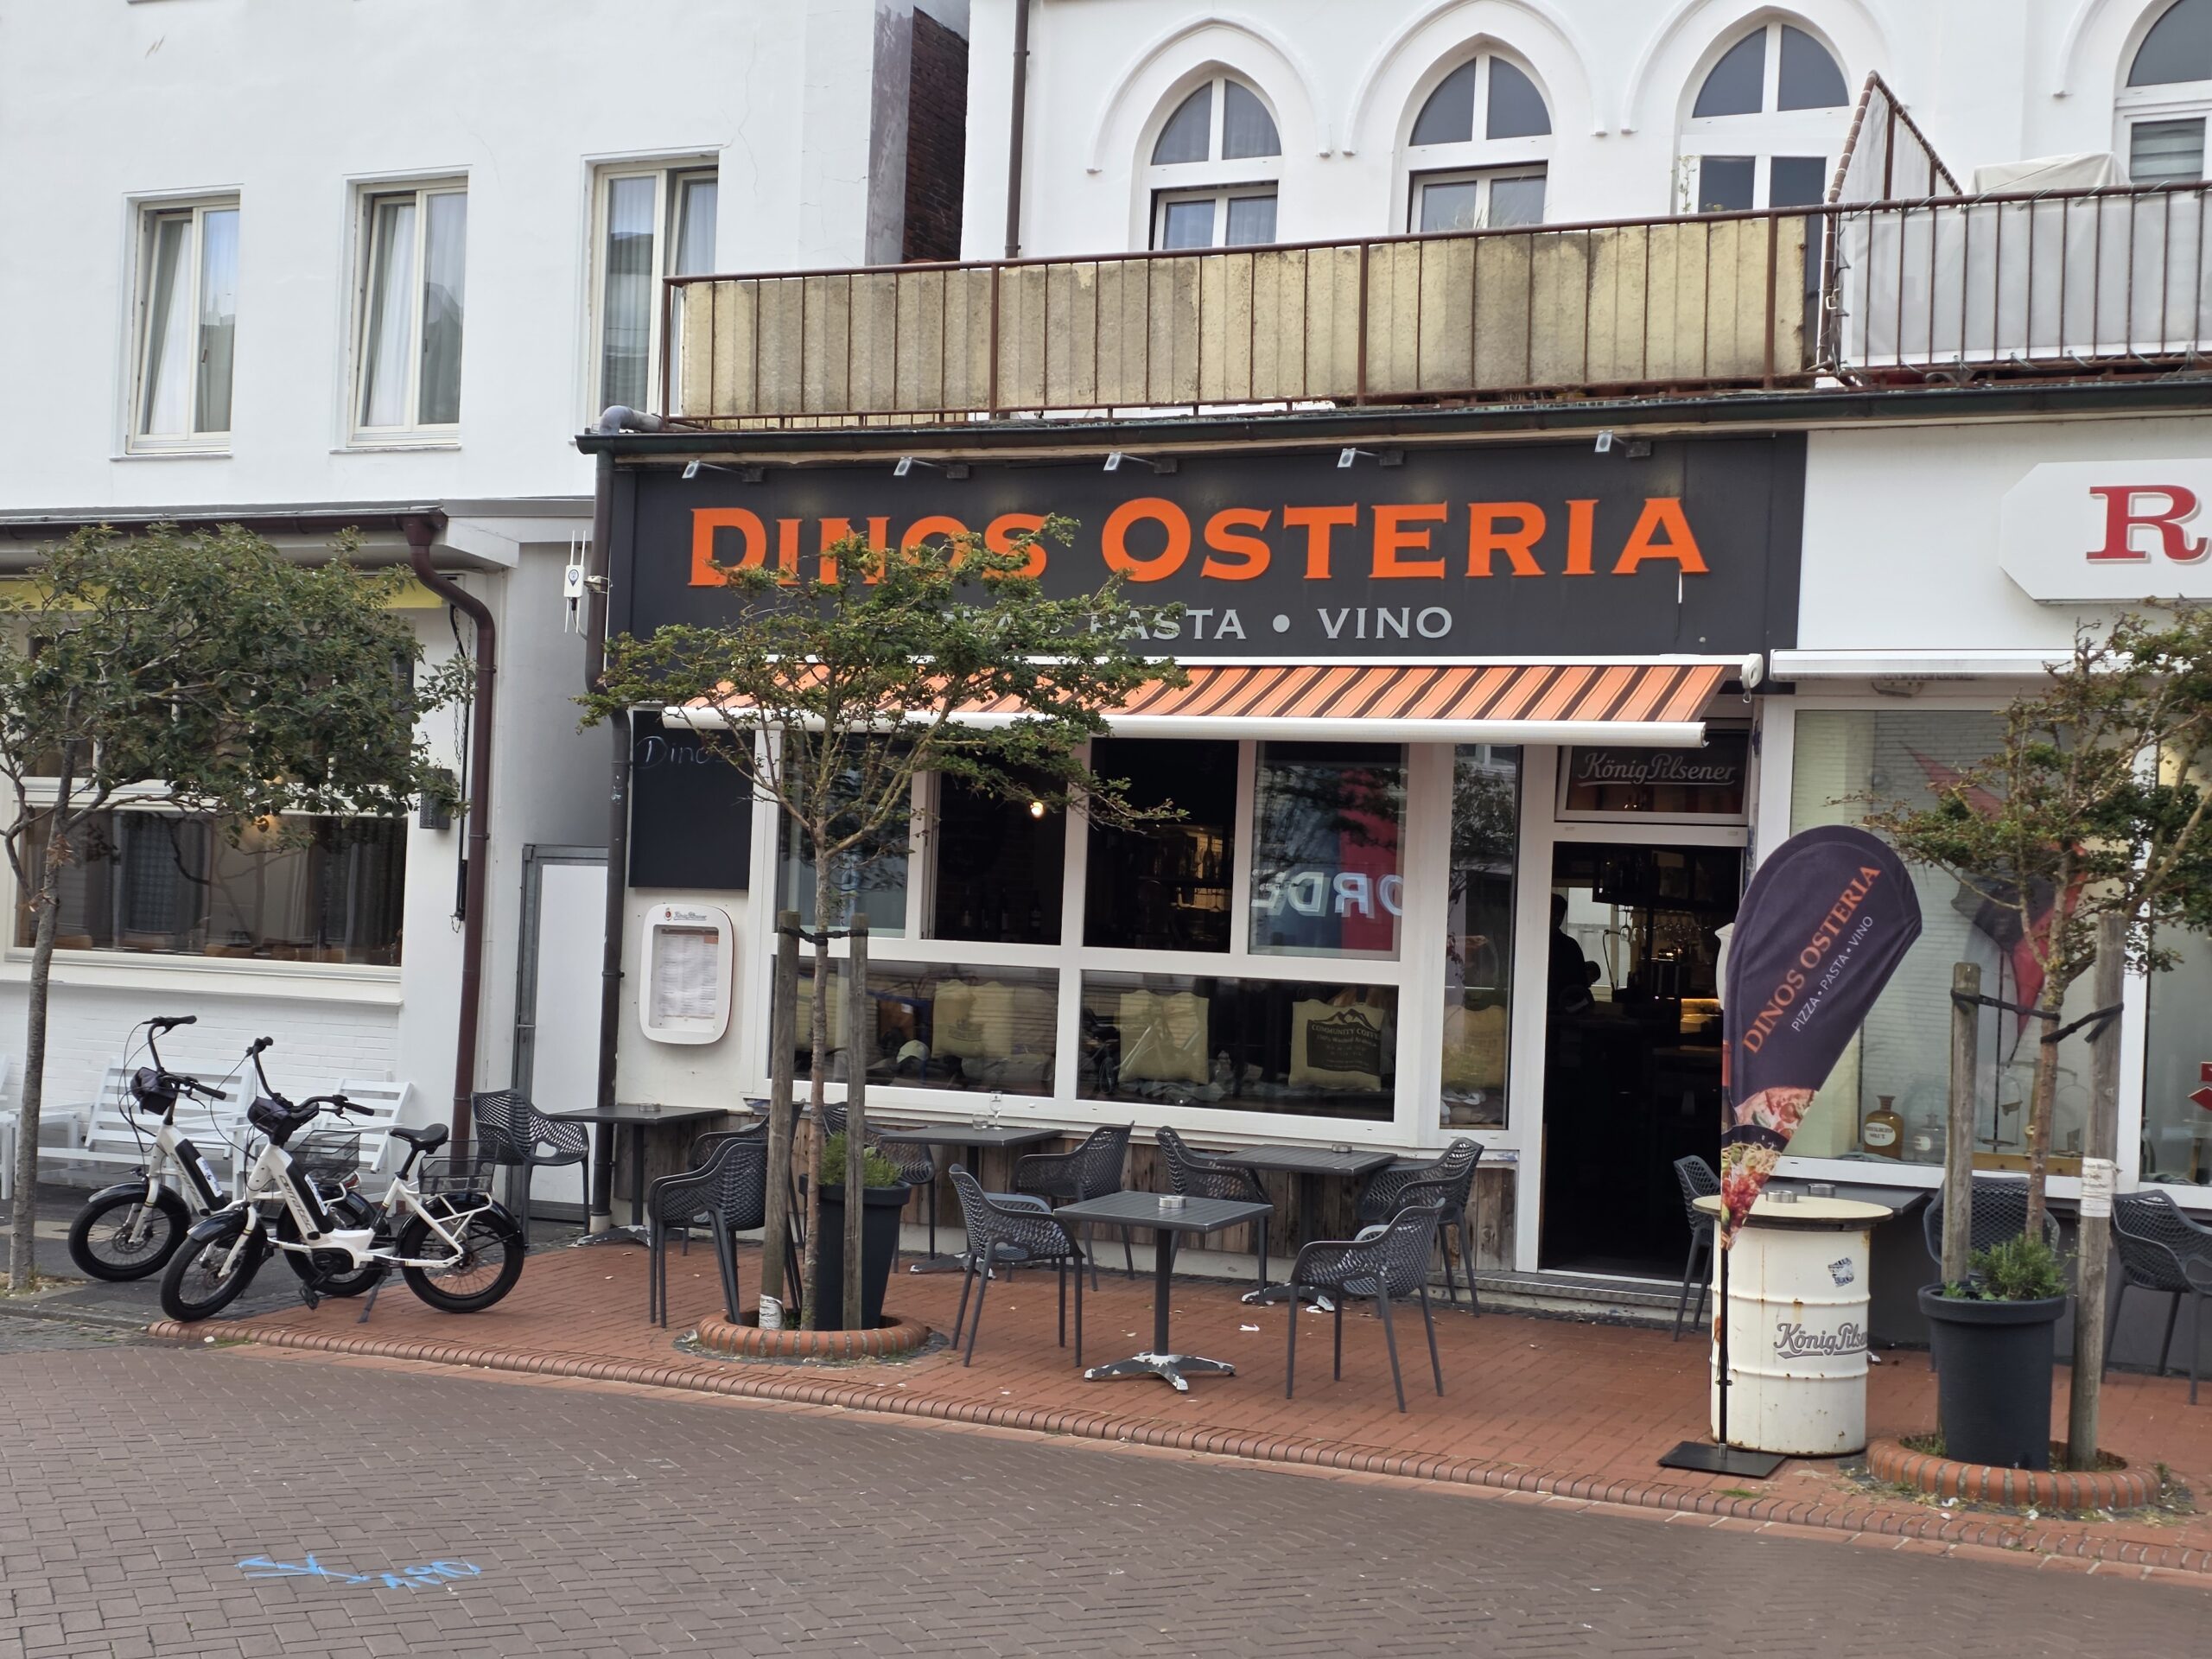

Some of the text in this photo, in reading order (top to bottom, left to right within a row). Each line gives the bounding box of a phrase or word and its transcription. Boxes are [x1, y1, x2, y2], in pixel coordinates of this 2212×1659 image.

[687, 496, 1711, 586] DINOS OSTERIA
[1317, 606, 1453, 639] VINO
[1578, 752, 1737, 785] König Pilsener
[1742, 866, 1881, 1054] DINOS OSTERIA
[1790, 916, 1874, 1033] PIZZA PASTA VINO
[1773, 1322, 1837, 1356] König
